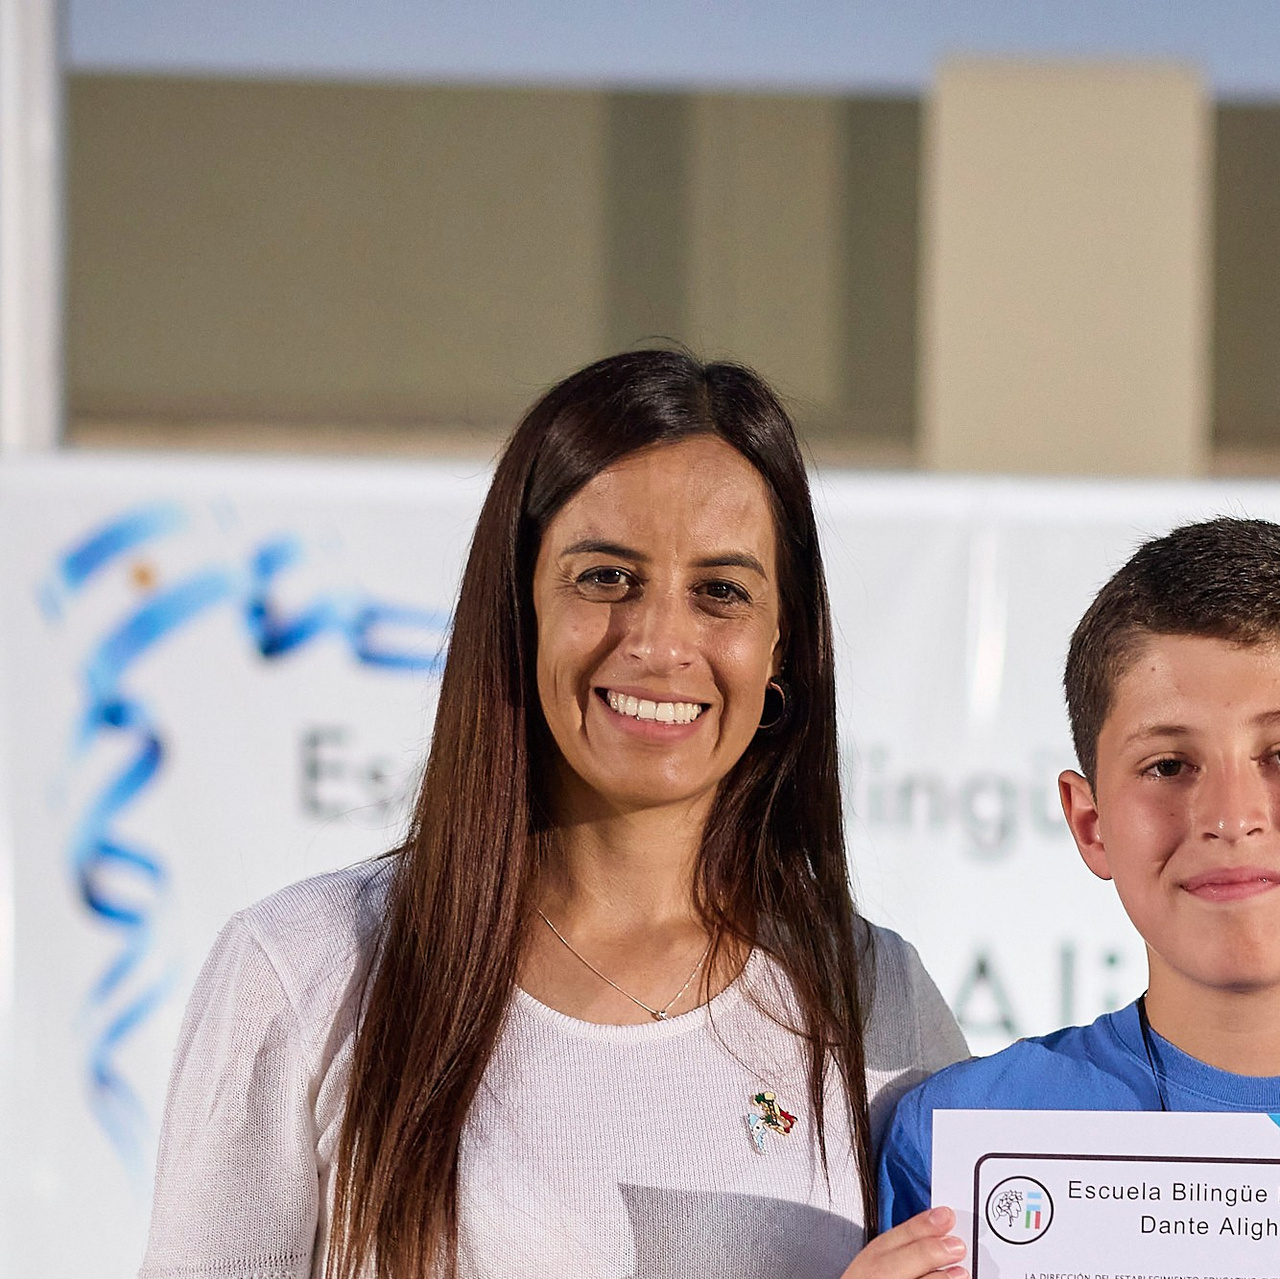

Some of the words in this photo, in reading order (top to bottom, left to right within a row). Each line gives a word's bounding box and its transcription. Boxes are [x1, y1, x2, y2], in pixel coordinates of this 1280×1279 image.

[1068, 1180, 1161, 1201] Escuela
[1172, 1182, 1268, 1207] Bilingüe
[1140, 1215, 1209, 1235] Dante
